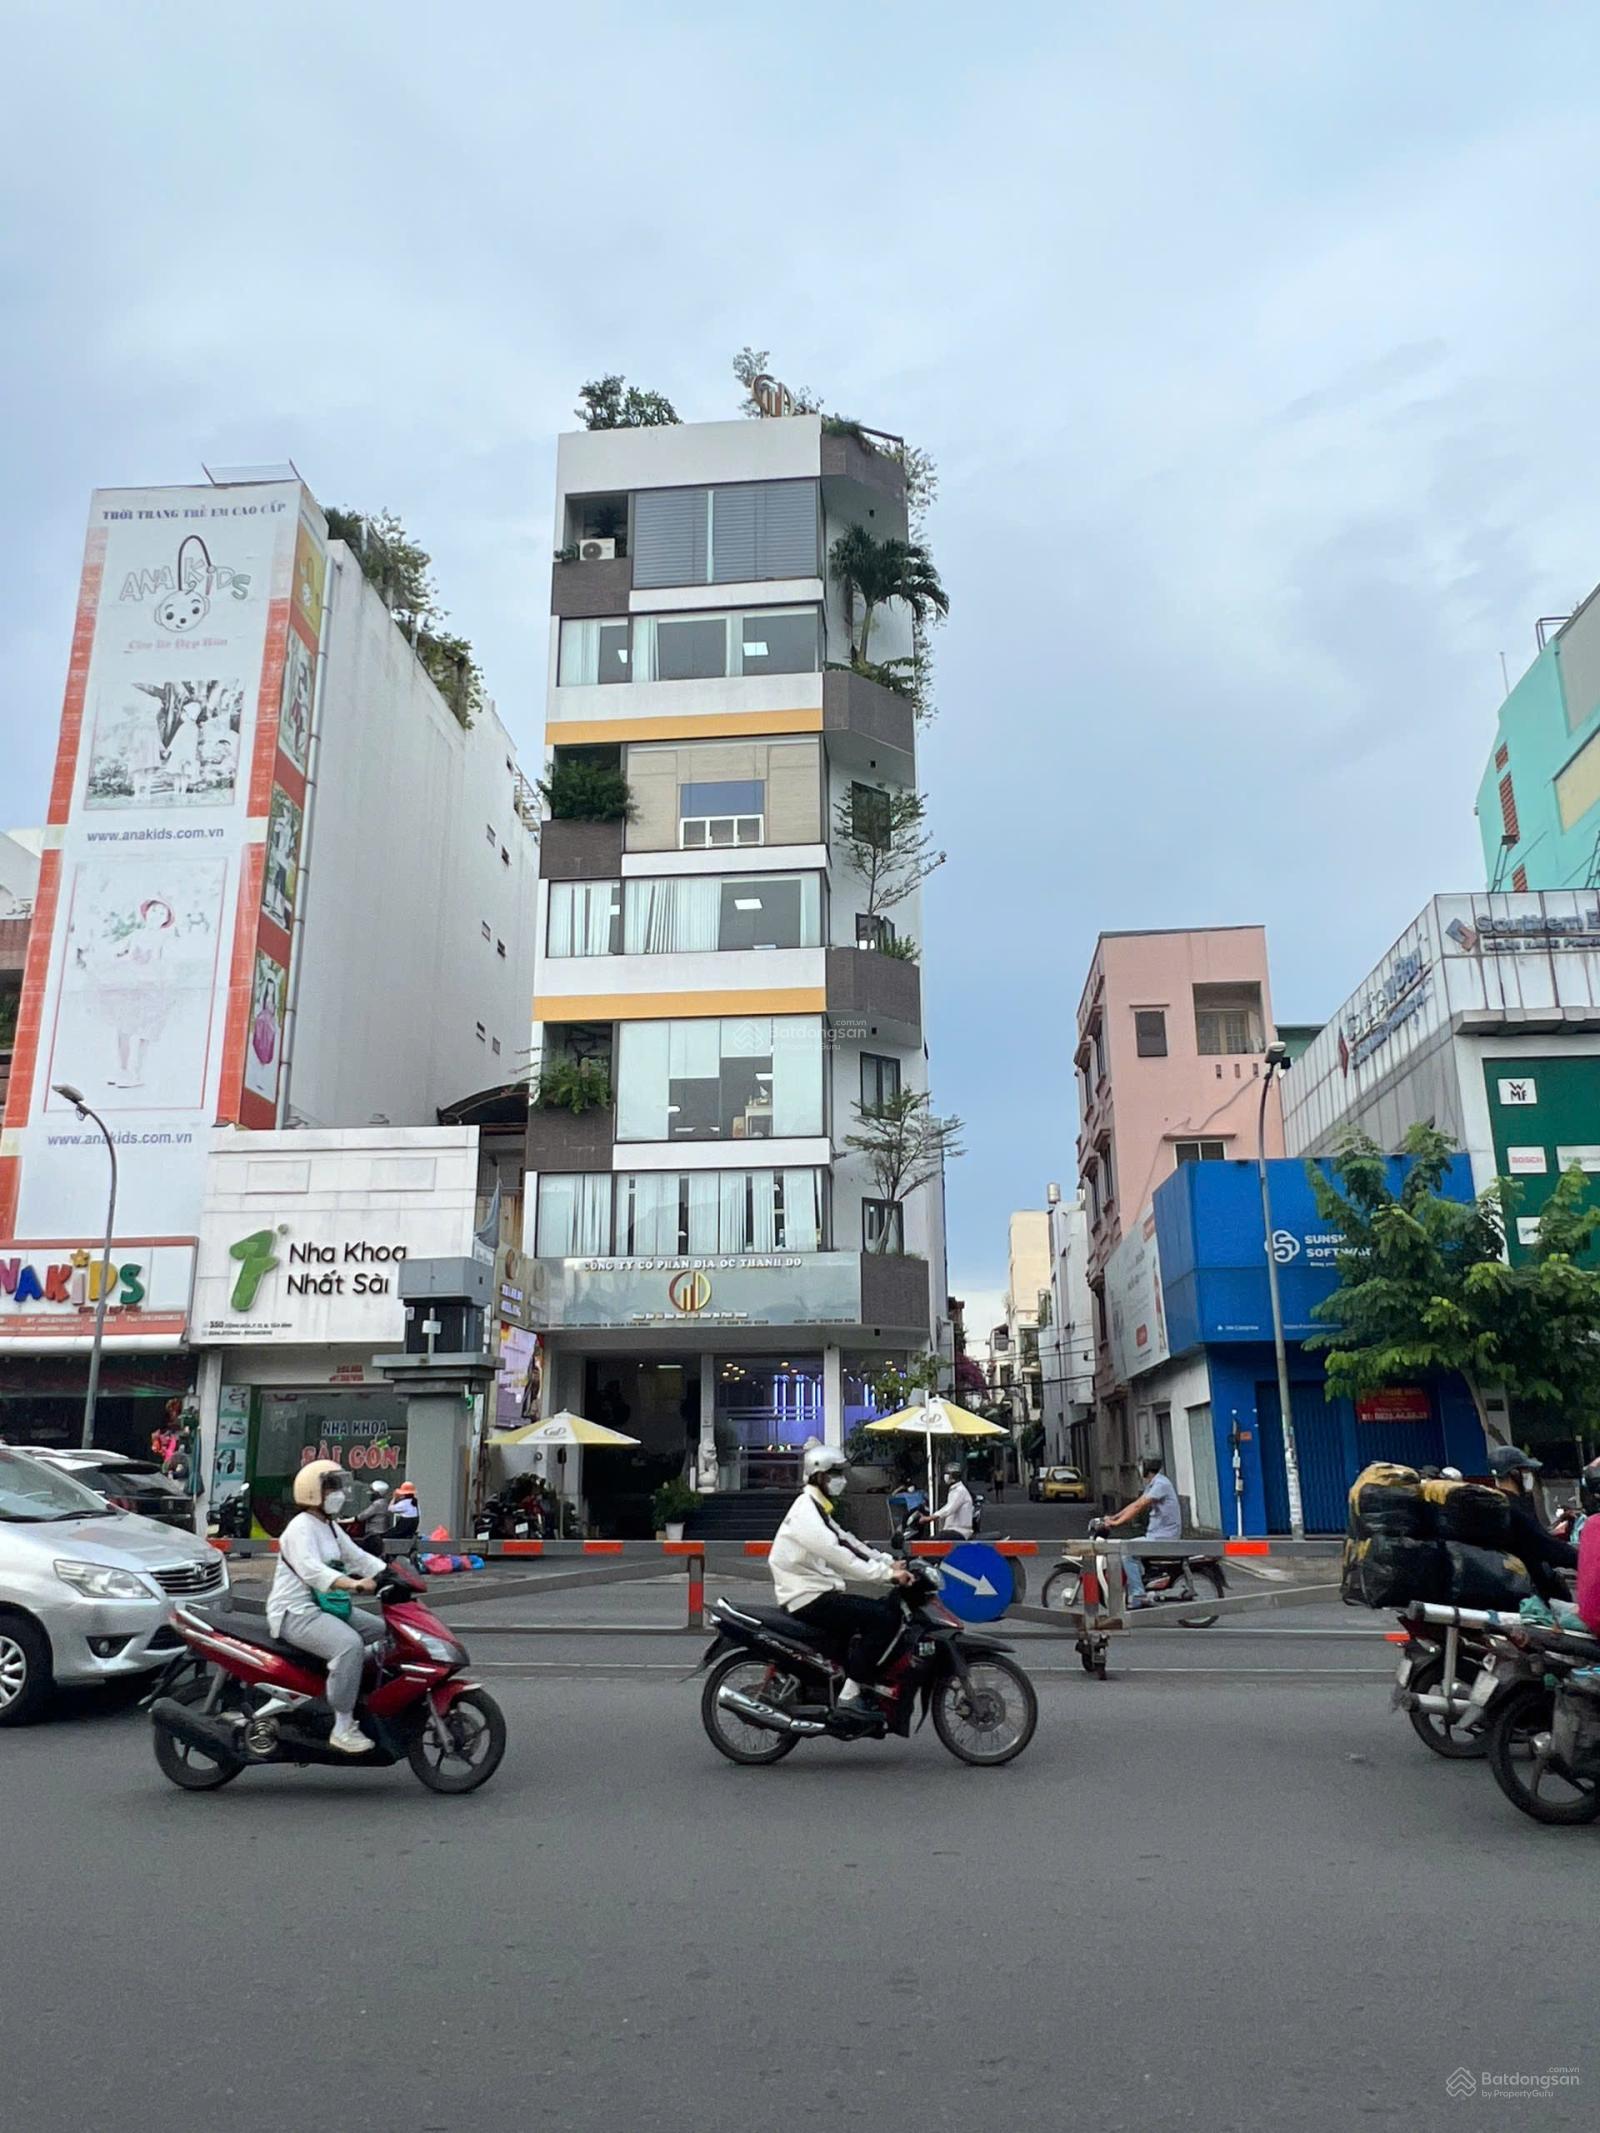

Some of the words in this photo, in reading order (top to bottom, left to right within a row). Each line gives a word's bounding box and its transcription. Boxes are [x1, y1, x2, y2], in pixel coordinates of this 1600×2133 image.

[138, 508, 179, 520] TRANG
[232, 504, 257, 516] CAO
[87, 828, 224, 841] www.anakids.com.vn
[289, 1242, 336, 1263] Nha
[344, 1241, 407, 1262] Khoa
[617, 1260, 635, 1271] TY
[287, 1270, 344, 1294] Nhất
[353, 1273, 389, 1294] Sài
[322, 1420, 348, 1436] NHA
[352, 1420, 387, 1436] KHOA
